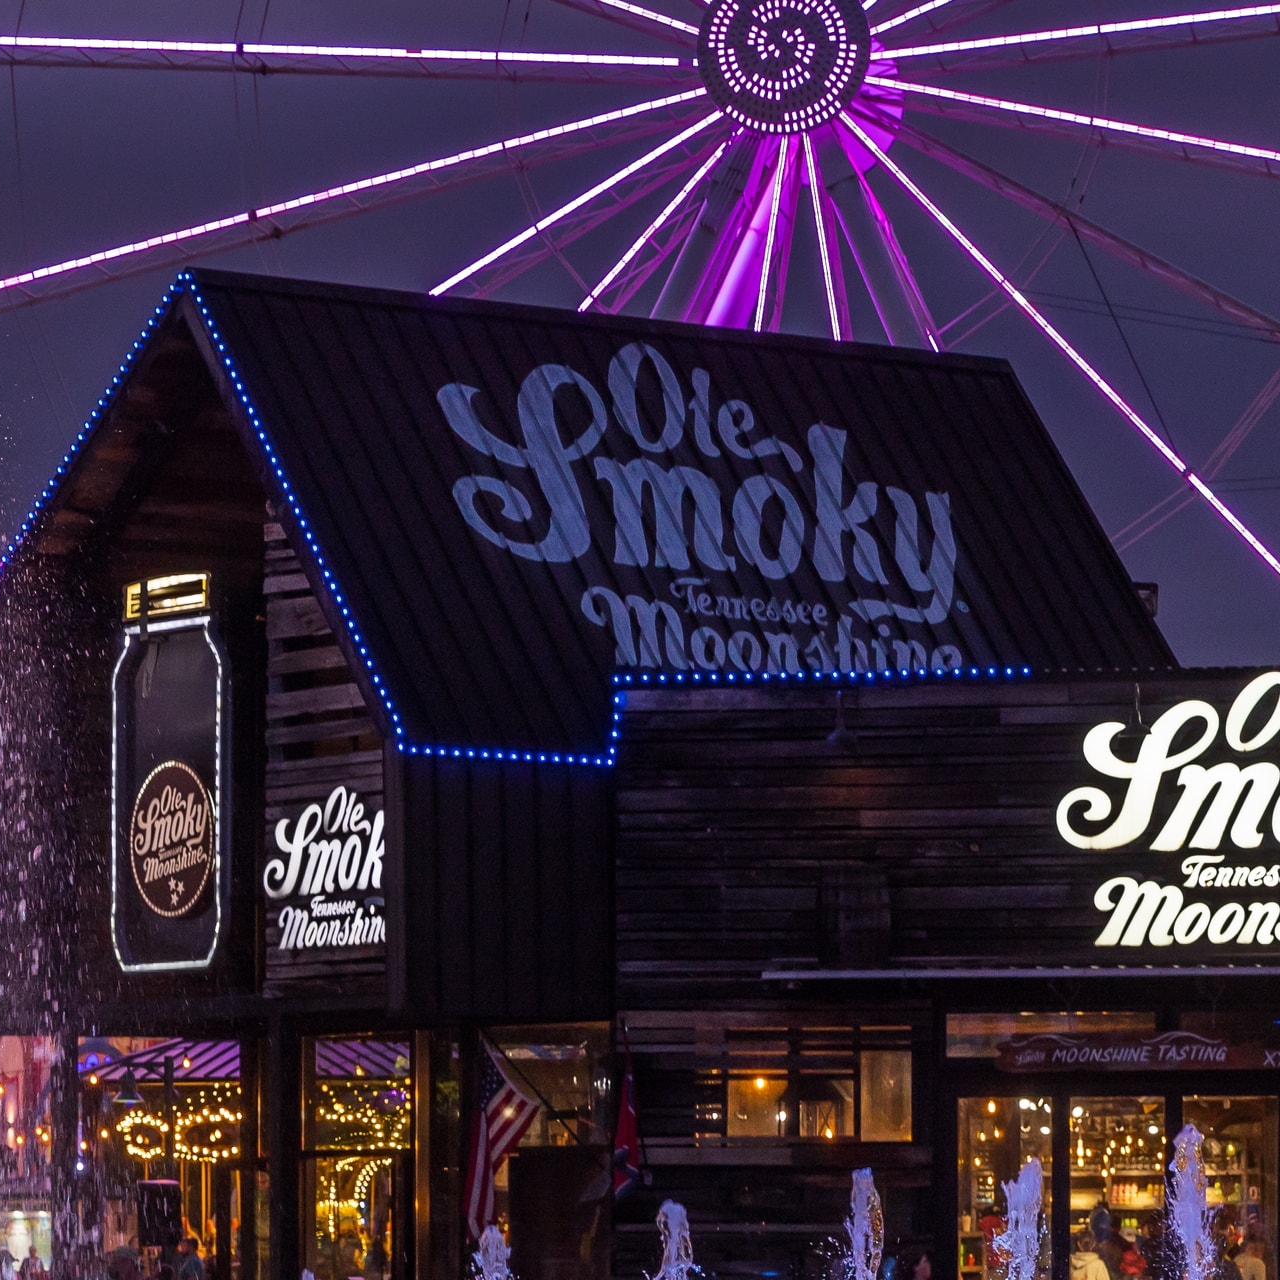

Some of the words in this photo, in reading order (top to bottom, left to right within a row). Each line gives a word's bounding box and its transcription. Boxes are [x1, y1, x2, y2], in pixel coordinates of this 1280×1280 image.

[609, 342, 801, 471] Ole
[437, 363, 958, 624] Smoky
[671, 577, 828, 626] Tennessee
[161, 785, 187, 815] Ole
[323, 785, 371, 836] Ole
[134, 792, 208, 856] Smoky
[143, 845, 208, 883] Moonshine
[278, 905, 386, 950] Moonshin
[310, 895, 357, 918] Tennessee
[1051, 1046, 1152, 1063] MOONSHINE
[1158, 1045, 1228, 1062] TASTING
